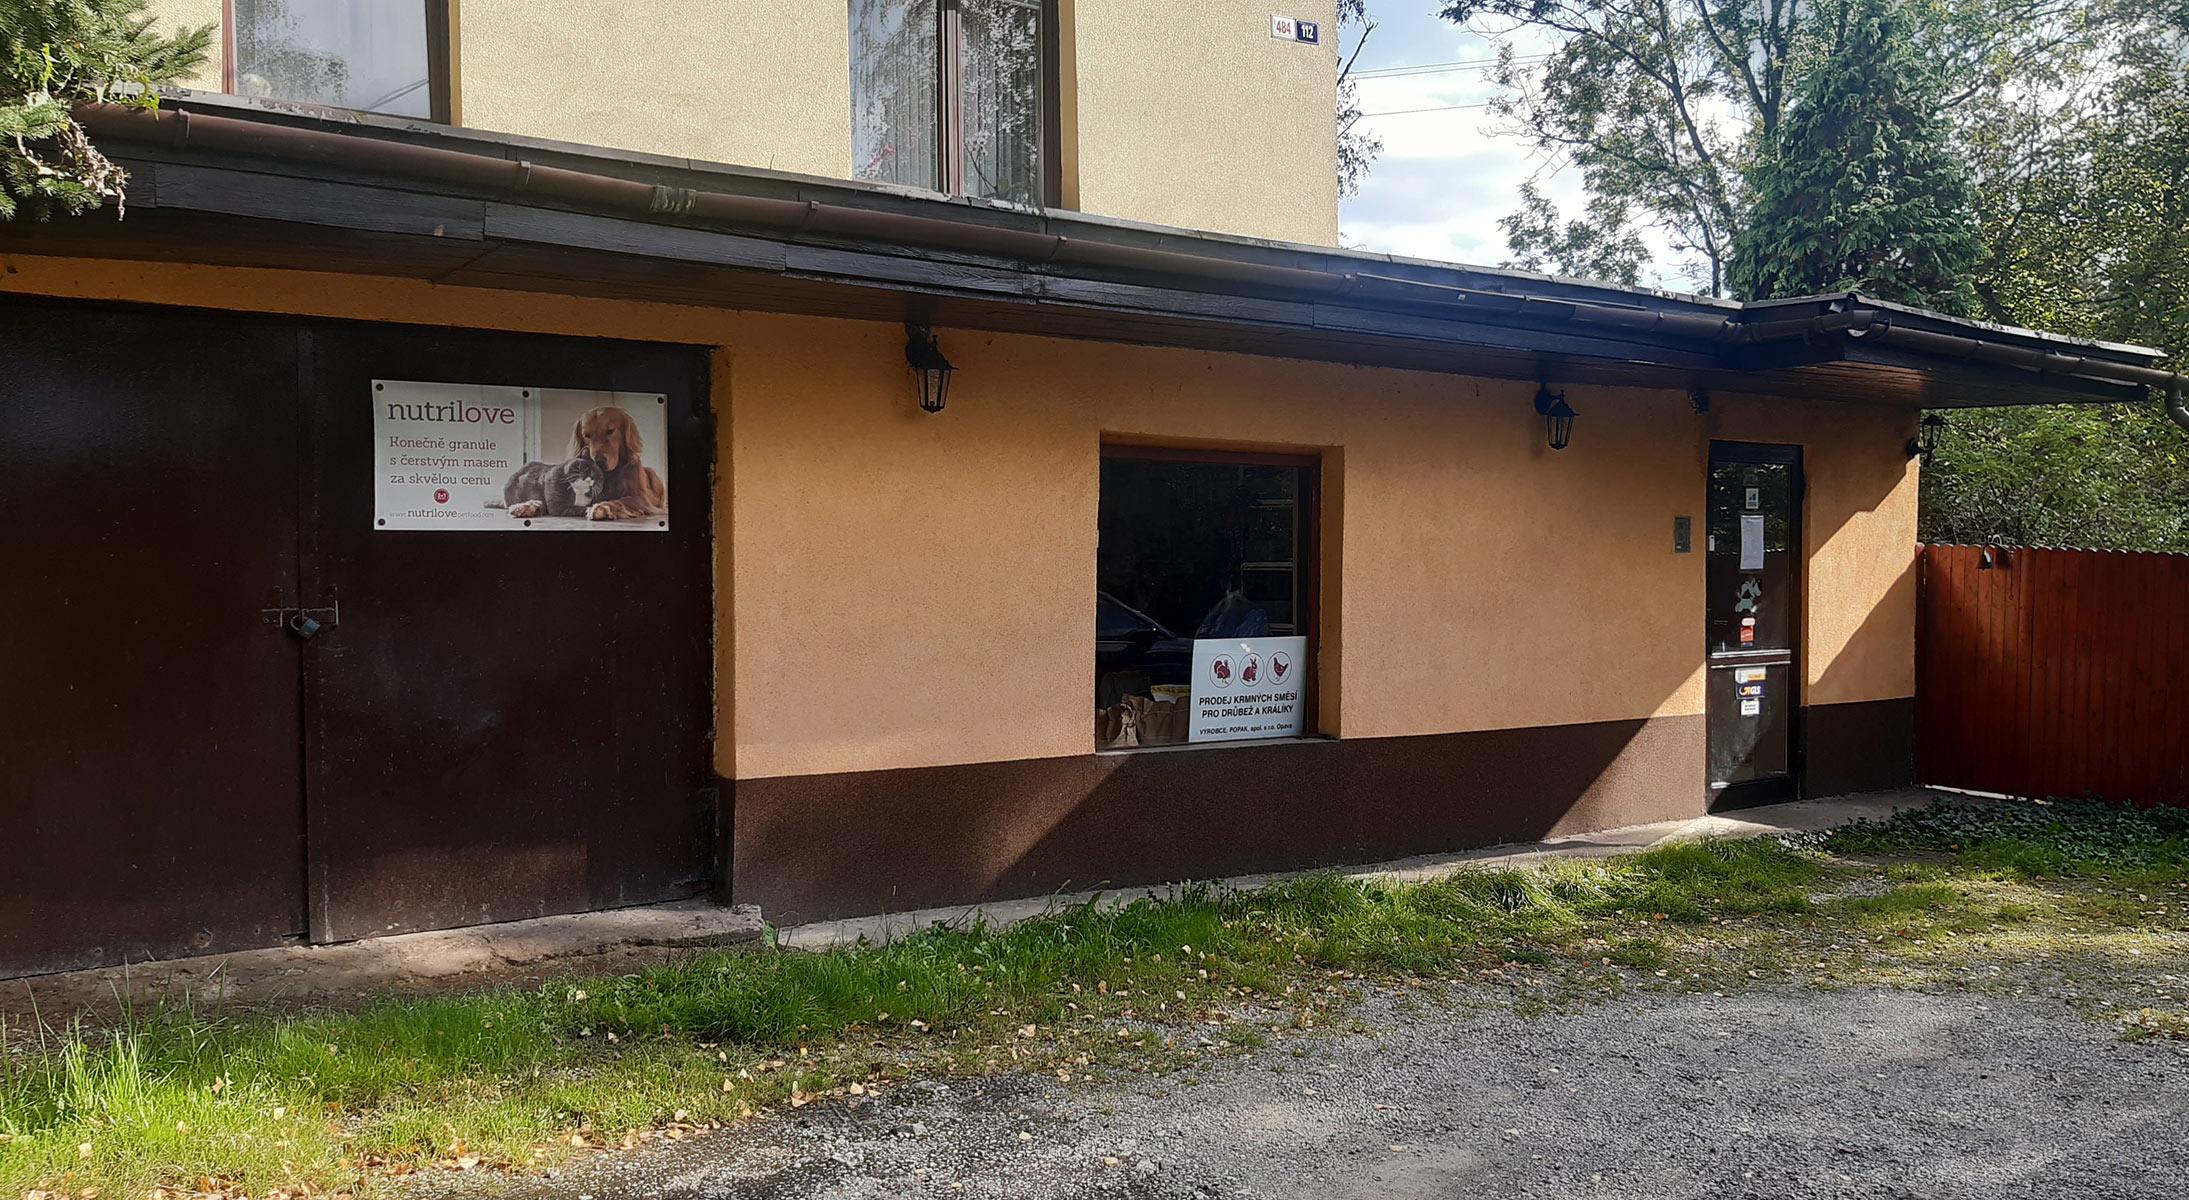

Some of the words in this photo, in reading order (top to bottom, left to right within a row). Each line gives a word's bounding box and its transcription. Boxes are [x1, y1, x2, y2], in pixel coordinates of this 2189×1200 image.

[1277, 20, 1291, 34] 484
[1301, 24, 1314, 39] 112
[388, 400, 515, 424] nutrilove
[389, 436, 445, 449] Konečně
[449, 439, 497, 452] granule
[390, 457, 397, 466] s
[400, 454, 459, 469] čerstvým
[463, 459, 508, 468] masem
[390, 475, 405, 484] za
[409, 473, 457, 485] skvělou
[461, 476, 491, 485] cenu
[1200, 696, 1231, 705] PRODEJ
[1234, 692, 1272, 703] KRMNÝCH
[1274, 690, 1298, 702] SMĚSÍ
[1202, 709, 1219, 718] PRO
[1221, 706, 1253, 717] DRŮBEŽ
[1254, 707, 1261, 716] A
[1262, 704, 1294, 715] KRÁLÍKY
